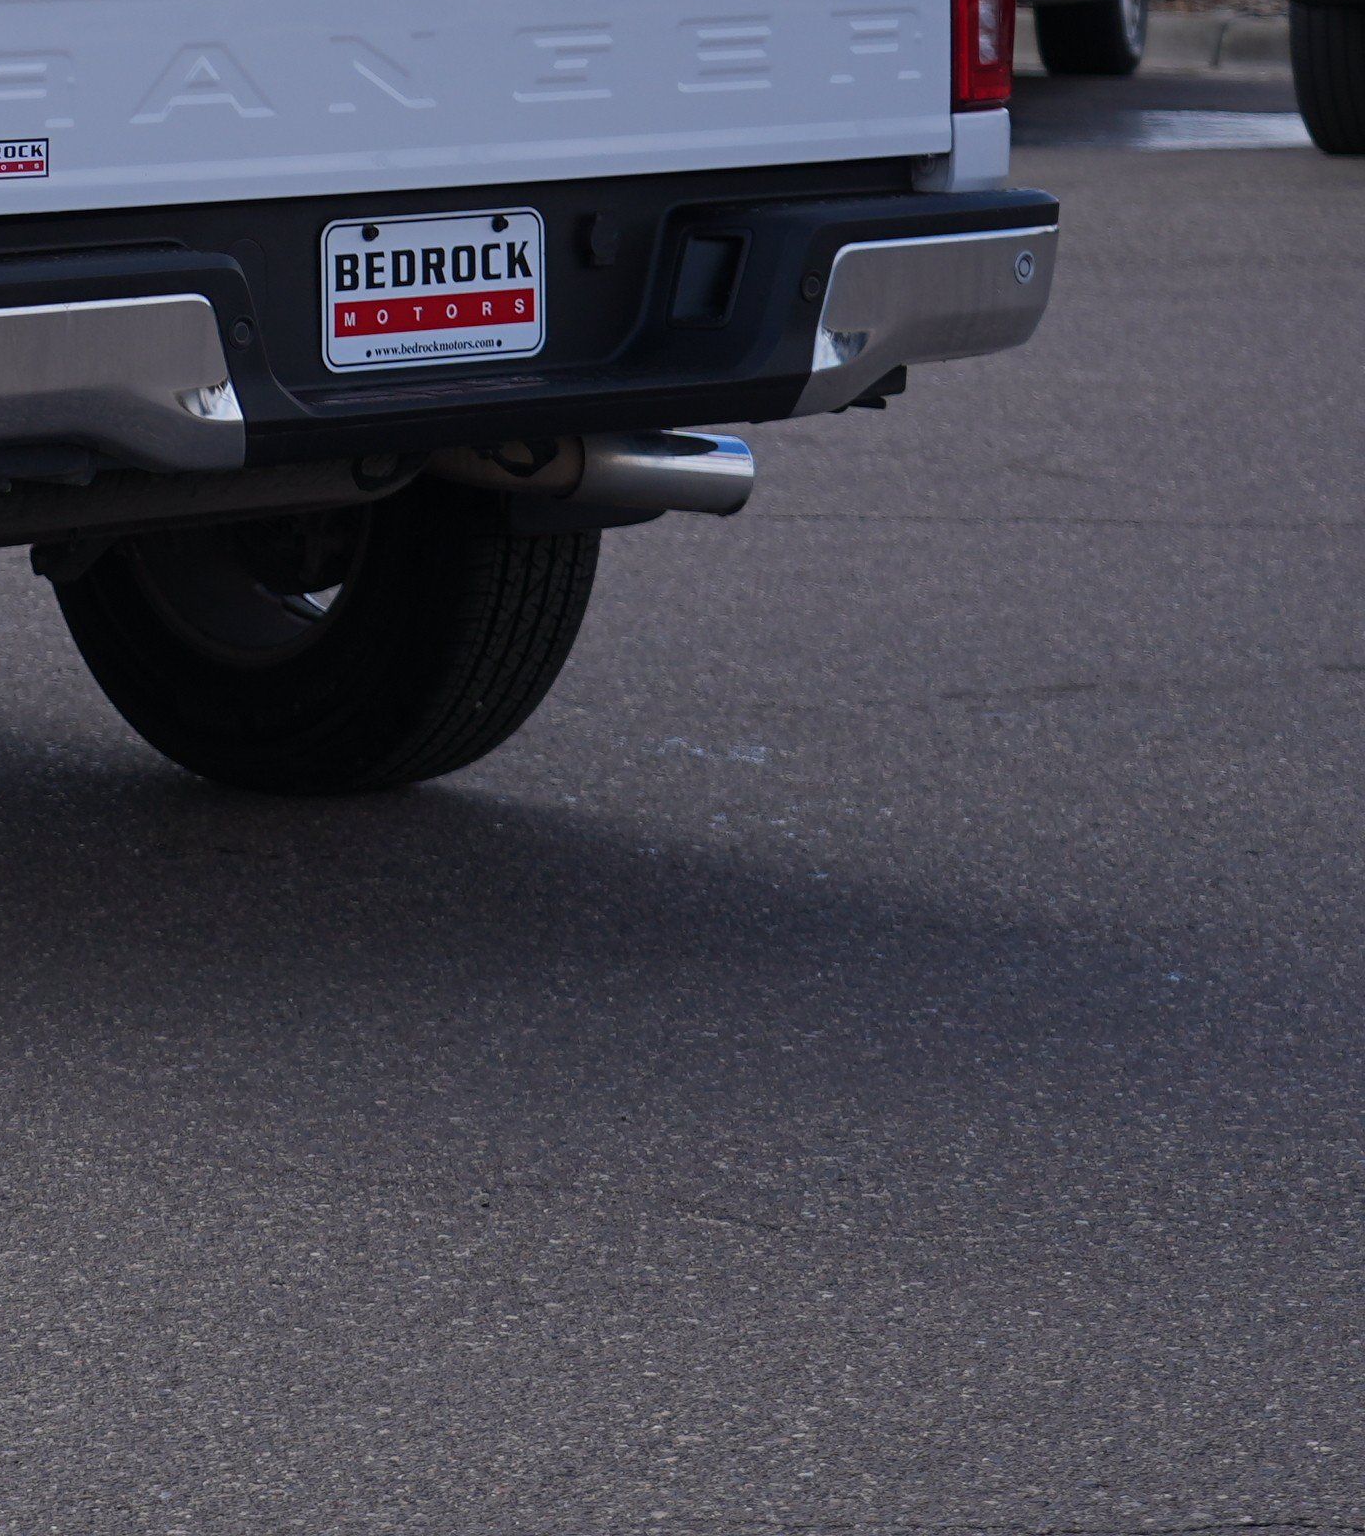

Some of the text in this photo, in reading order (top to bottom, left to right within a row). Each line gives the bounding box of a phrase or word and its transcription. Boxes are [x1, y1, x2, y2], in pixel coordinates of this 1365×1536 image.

[334, 241, 533, 292] BEDROCK
[344, 298, 526, 327] MOTORS
[374, 337, 495, 357] www.bedrockmotors.com
